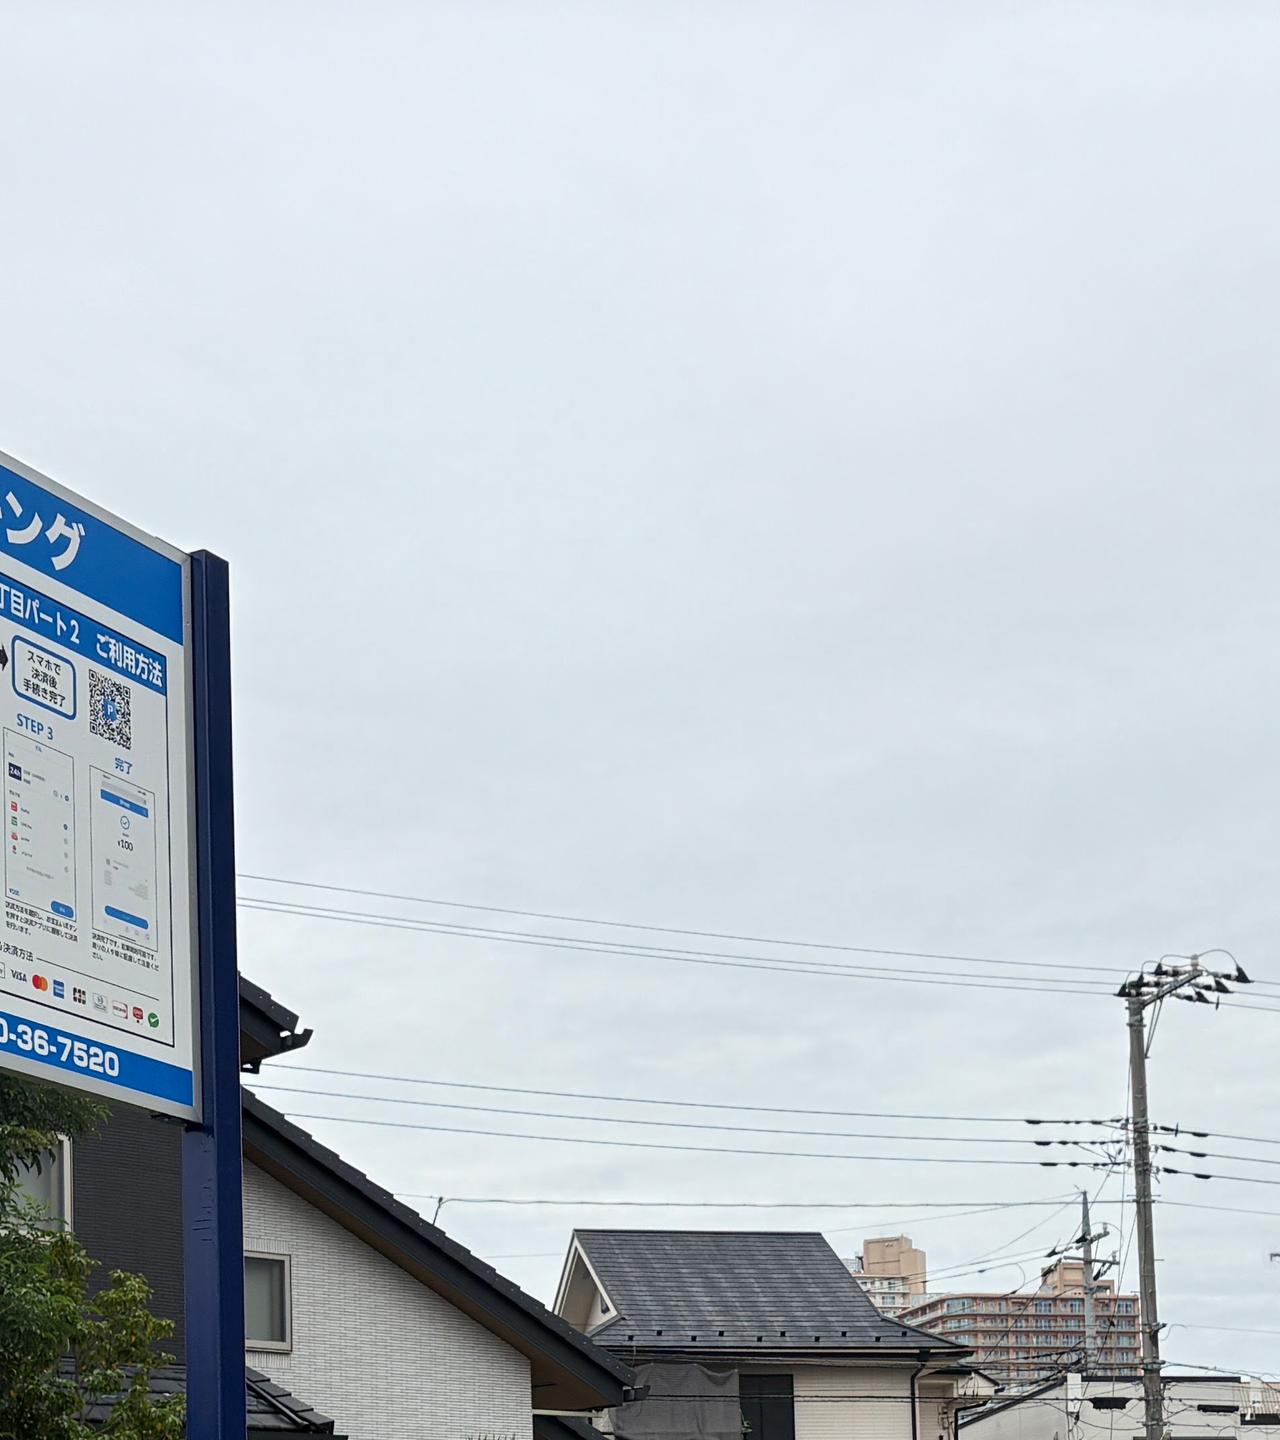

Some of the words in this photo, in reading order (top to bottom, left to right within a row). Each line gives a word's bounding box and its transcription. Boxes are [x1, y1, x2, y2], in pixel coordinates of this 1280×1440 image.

[26, 650, 62, 673] スマホで
[96, 632, 164, 688] ご利用方法
[30, 666, 58, 690] 決済後
[23, 678, 67, 708] 手続き完了
[16, 713, 44, 736] STEP
[47, 726, 54, 740] 3
[114, 756, 133, 775] 完了
[11, 968, 28, 983] VISA
